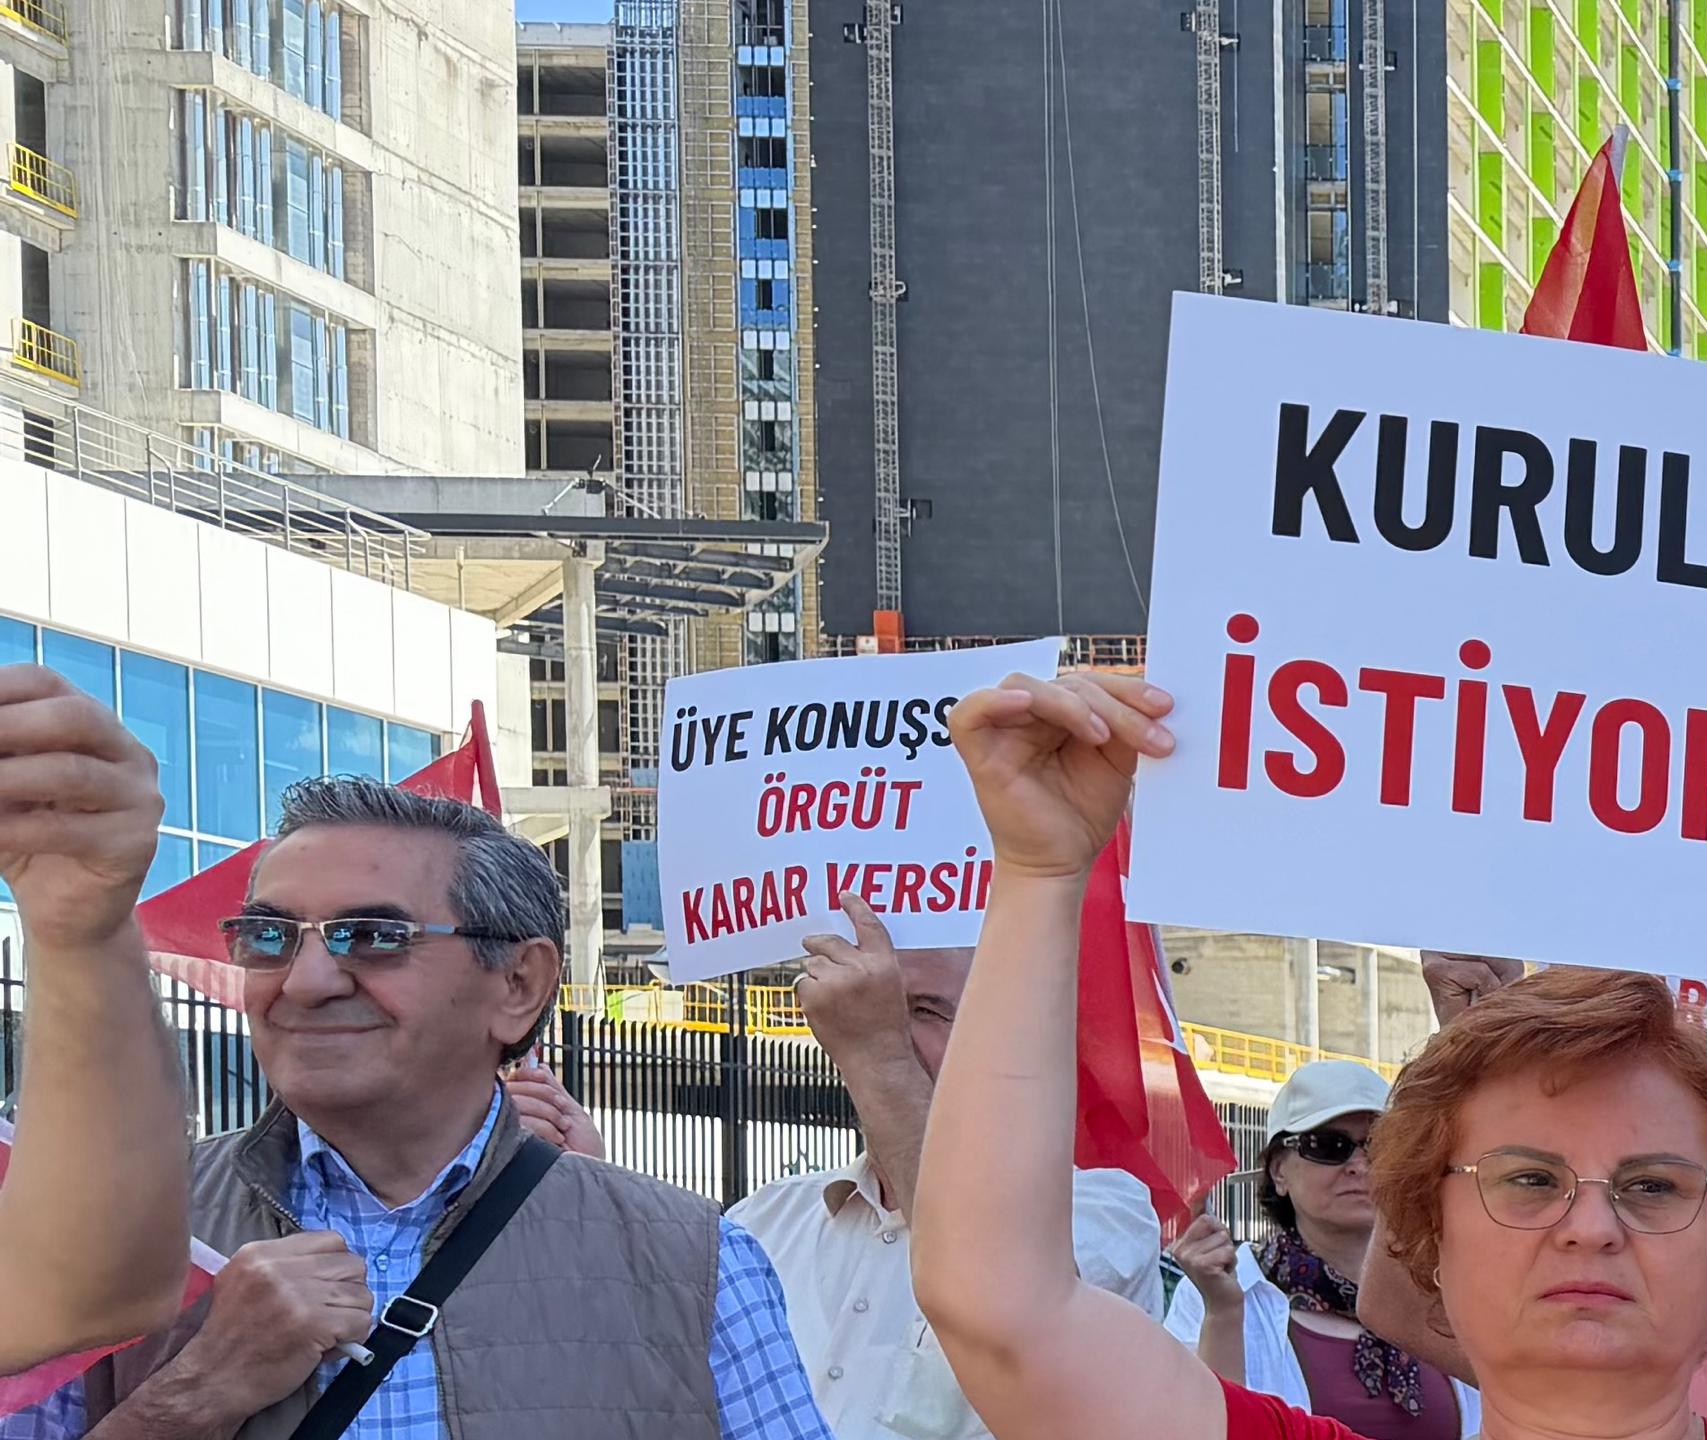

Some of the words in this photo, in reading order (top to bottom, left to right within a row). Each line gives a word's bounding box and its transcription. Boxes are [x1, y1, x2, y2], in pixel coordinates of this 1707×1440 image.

[670, 705, 754, 772] ÜYE
[757, 766, 922, 838] ÖRGÜT
[682, 865, 808, 945] KARAR
